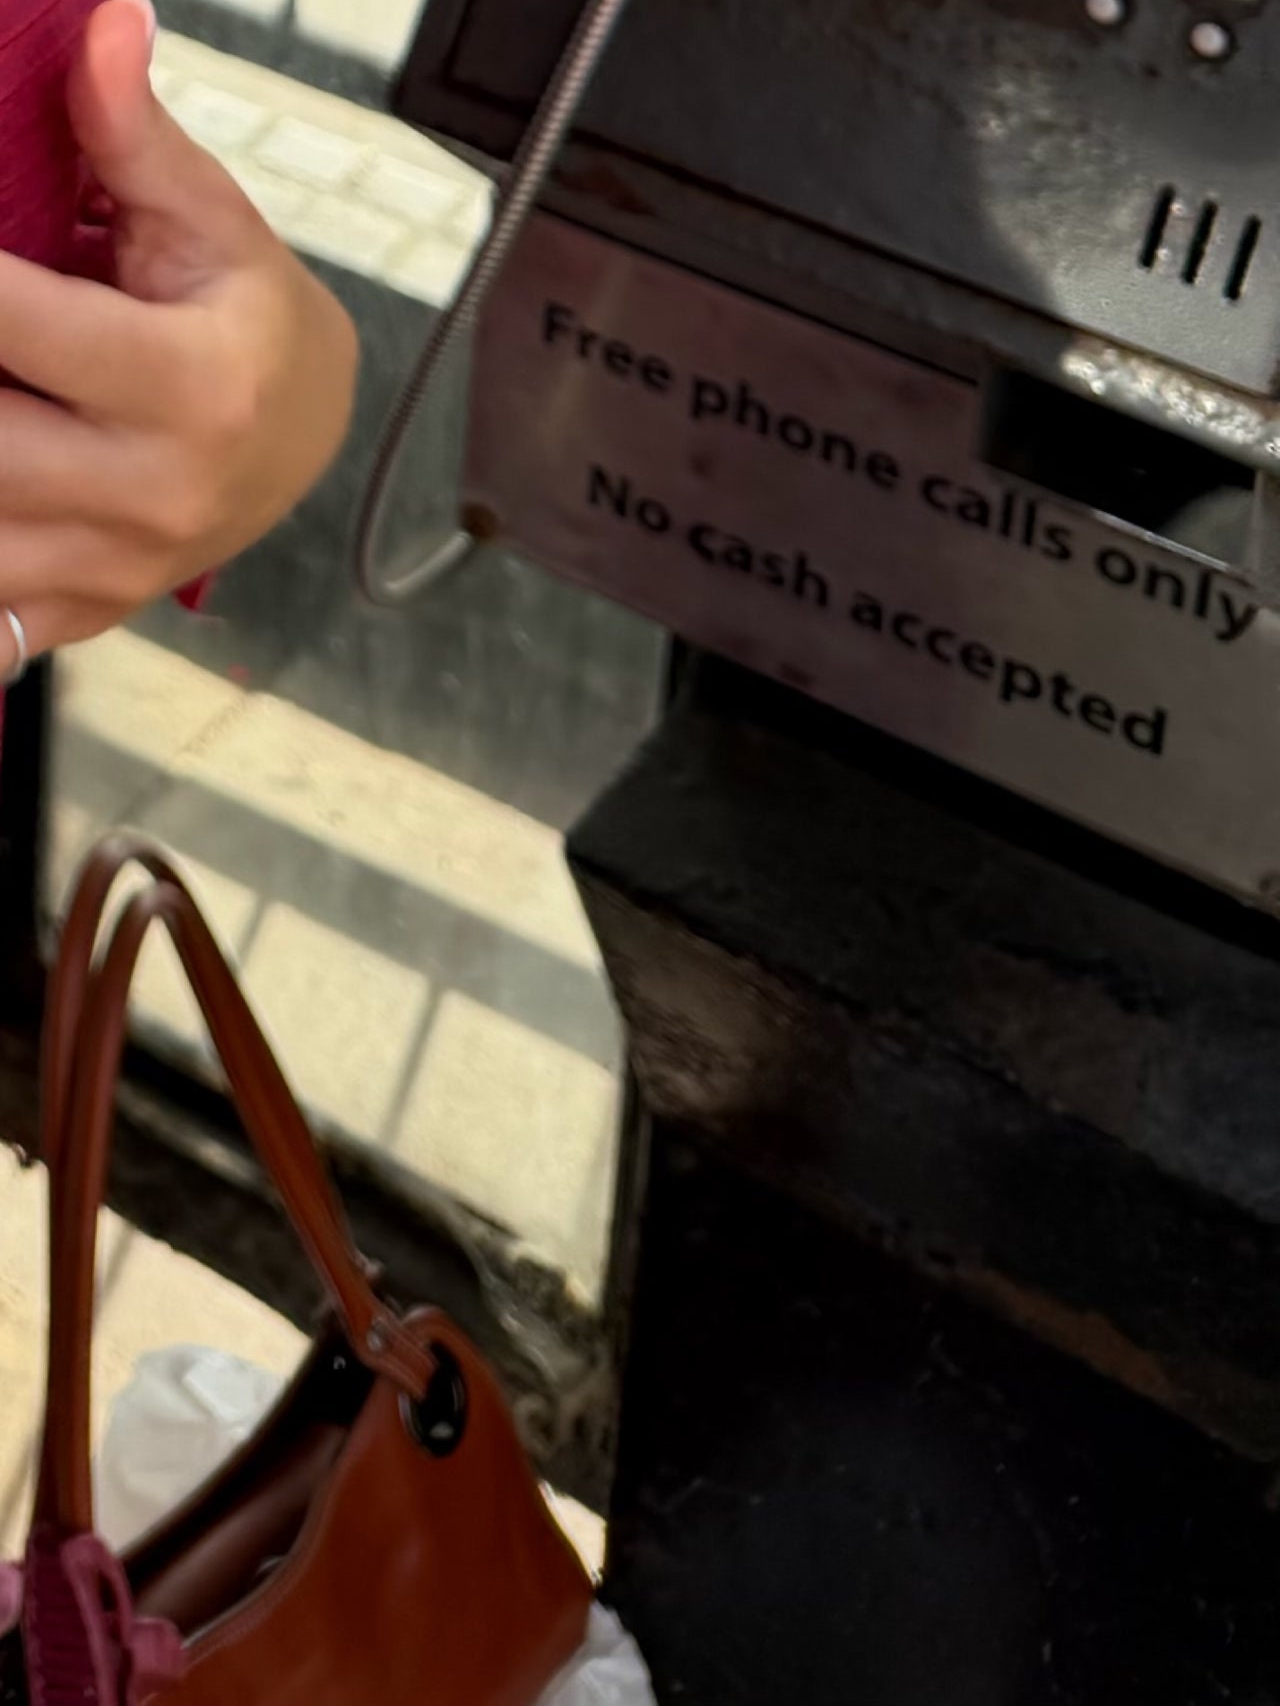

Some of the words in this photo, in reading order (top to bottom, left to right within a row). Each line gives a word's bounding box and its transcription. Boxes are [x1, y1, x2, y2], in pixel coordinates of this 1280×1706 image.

[538, 299, 675, 394] Free
[689, 372, 900, 491] phone
[917, 466, 1075, 565] calls
[1093, 534, 1259, 644] only
[584, 464, 672, 536] No
[686, 522, 833, 612] cash
[849, 588, 1172, 758] accepted
